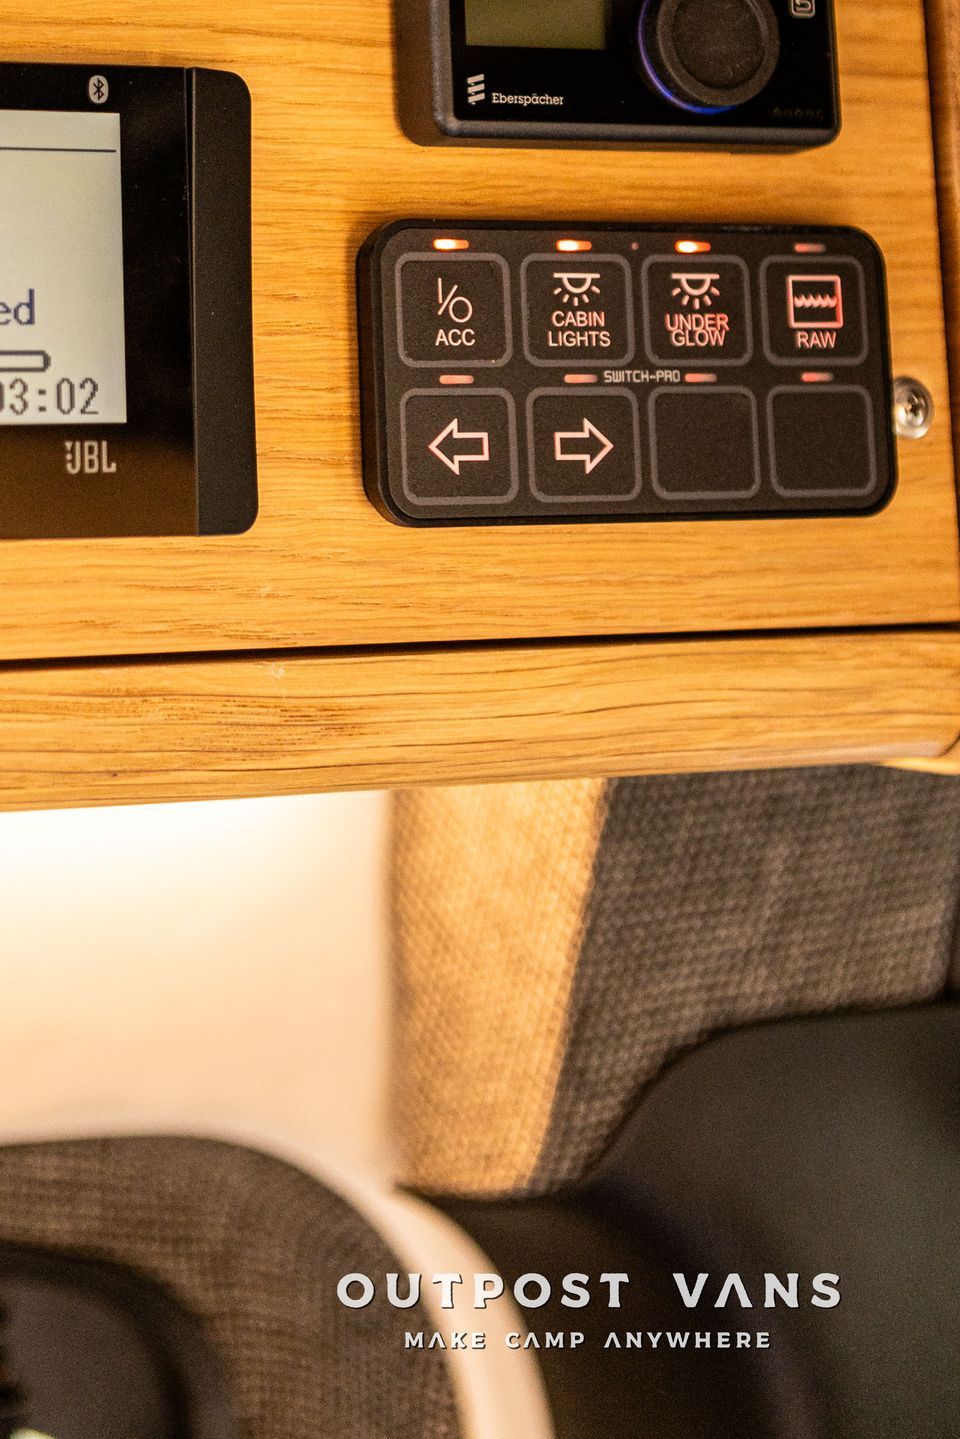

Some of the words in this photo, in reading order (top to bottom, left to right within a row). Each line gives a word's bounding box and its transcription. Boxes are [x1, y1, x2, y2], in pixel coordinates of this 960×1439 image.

[491, 92, 565, 107] Eberspächer
[551, 310, 605, 328] CABIN
[665, 313, 730, 332] UNDER
[435, 328, 476, 346] ACC
[547, 330, 611, 348] LIGHTS
[671, 329, 726, 347] GLOW
[795, 331, 837, 349] RAW
[603, 369, 681, 384] SWITCH-PRO
[64, 440, 117, 474] JBL
